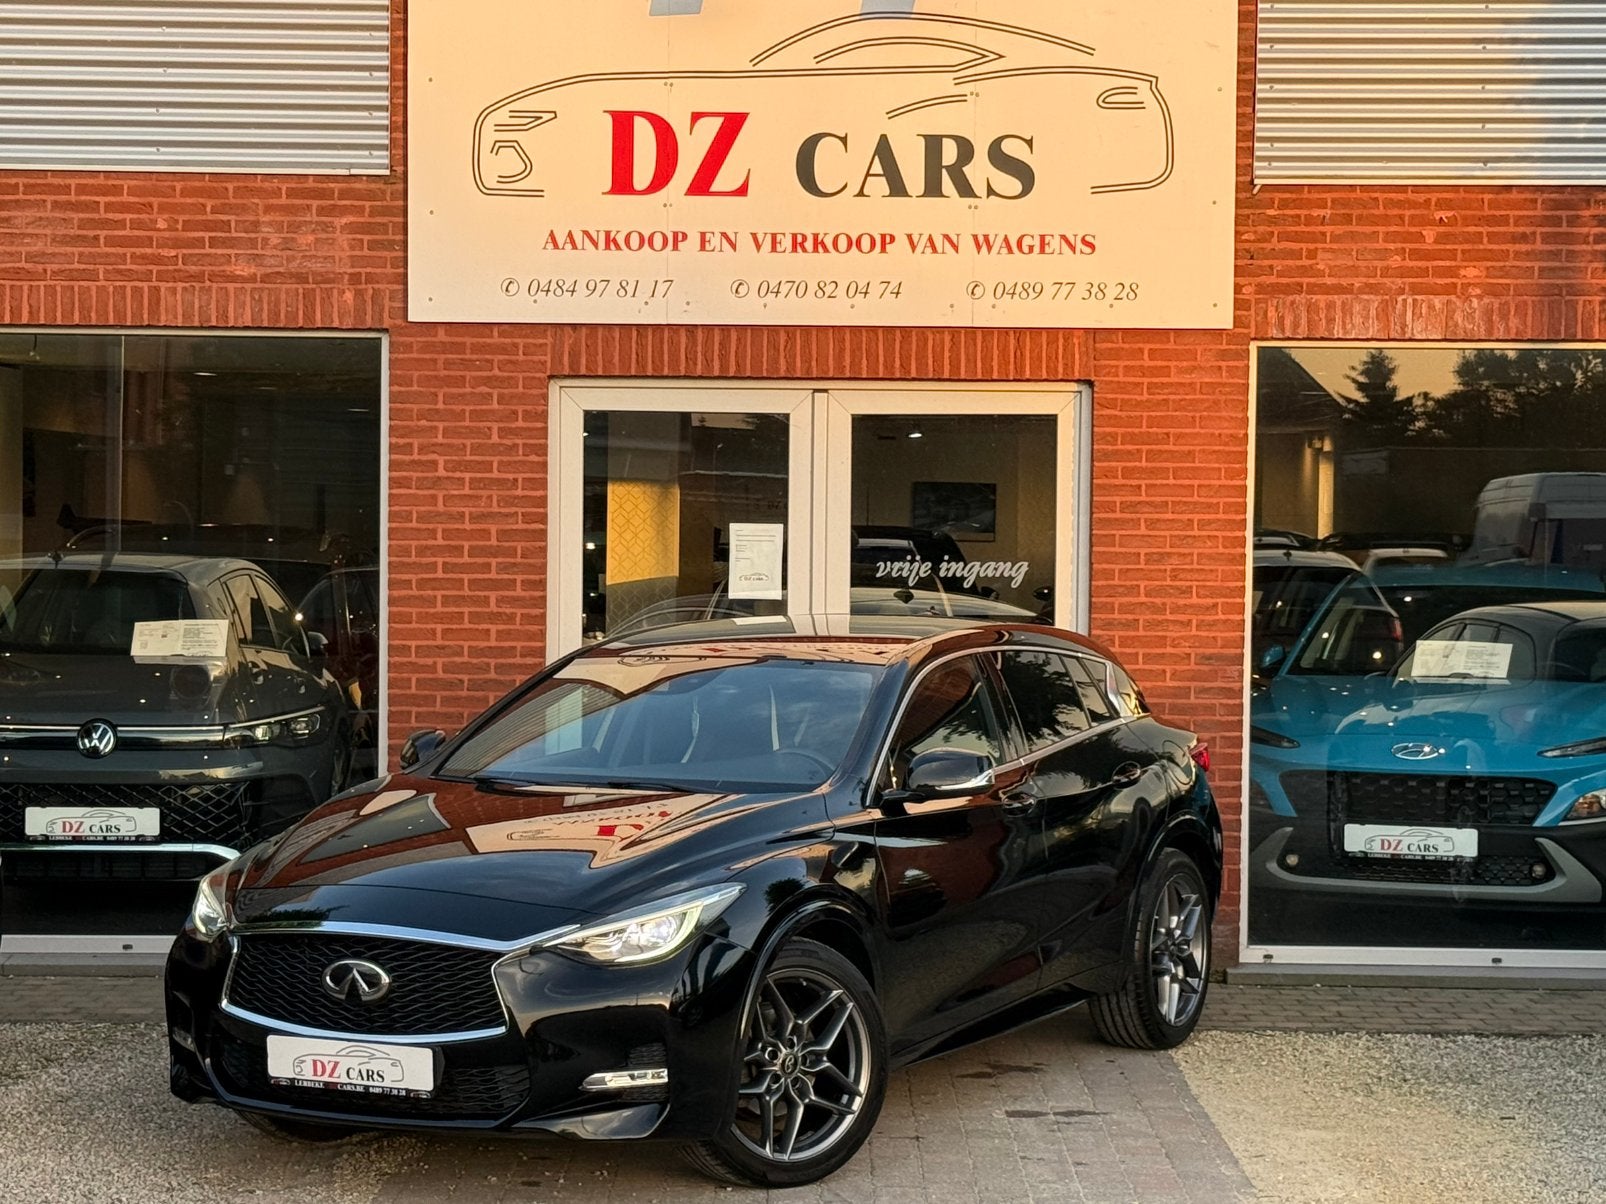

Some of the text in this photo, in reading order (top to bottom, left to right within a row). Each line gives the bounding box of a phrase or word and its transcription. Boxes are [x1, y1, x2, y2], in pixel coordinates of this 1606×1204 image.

[601, 109, 1036, 201] DZ CARS
[542, 228, 1097, 257] AANKOOP EN VERKOOP VAN WAGENS
[527, 278, 675, 299] 0484 97 81 17
[757, 279, 904, 301] 0470 82 04 74
[992, 280, 1140, 302] 0489 77 38 28
[876, 555, 1029, 588] vrije ingang
[62, 820, 121, 834] DZ CARS
[1380, 838, 1439, 853] DZ CARS
[311, 1058, 385, 1083] DZ CARS
